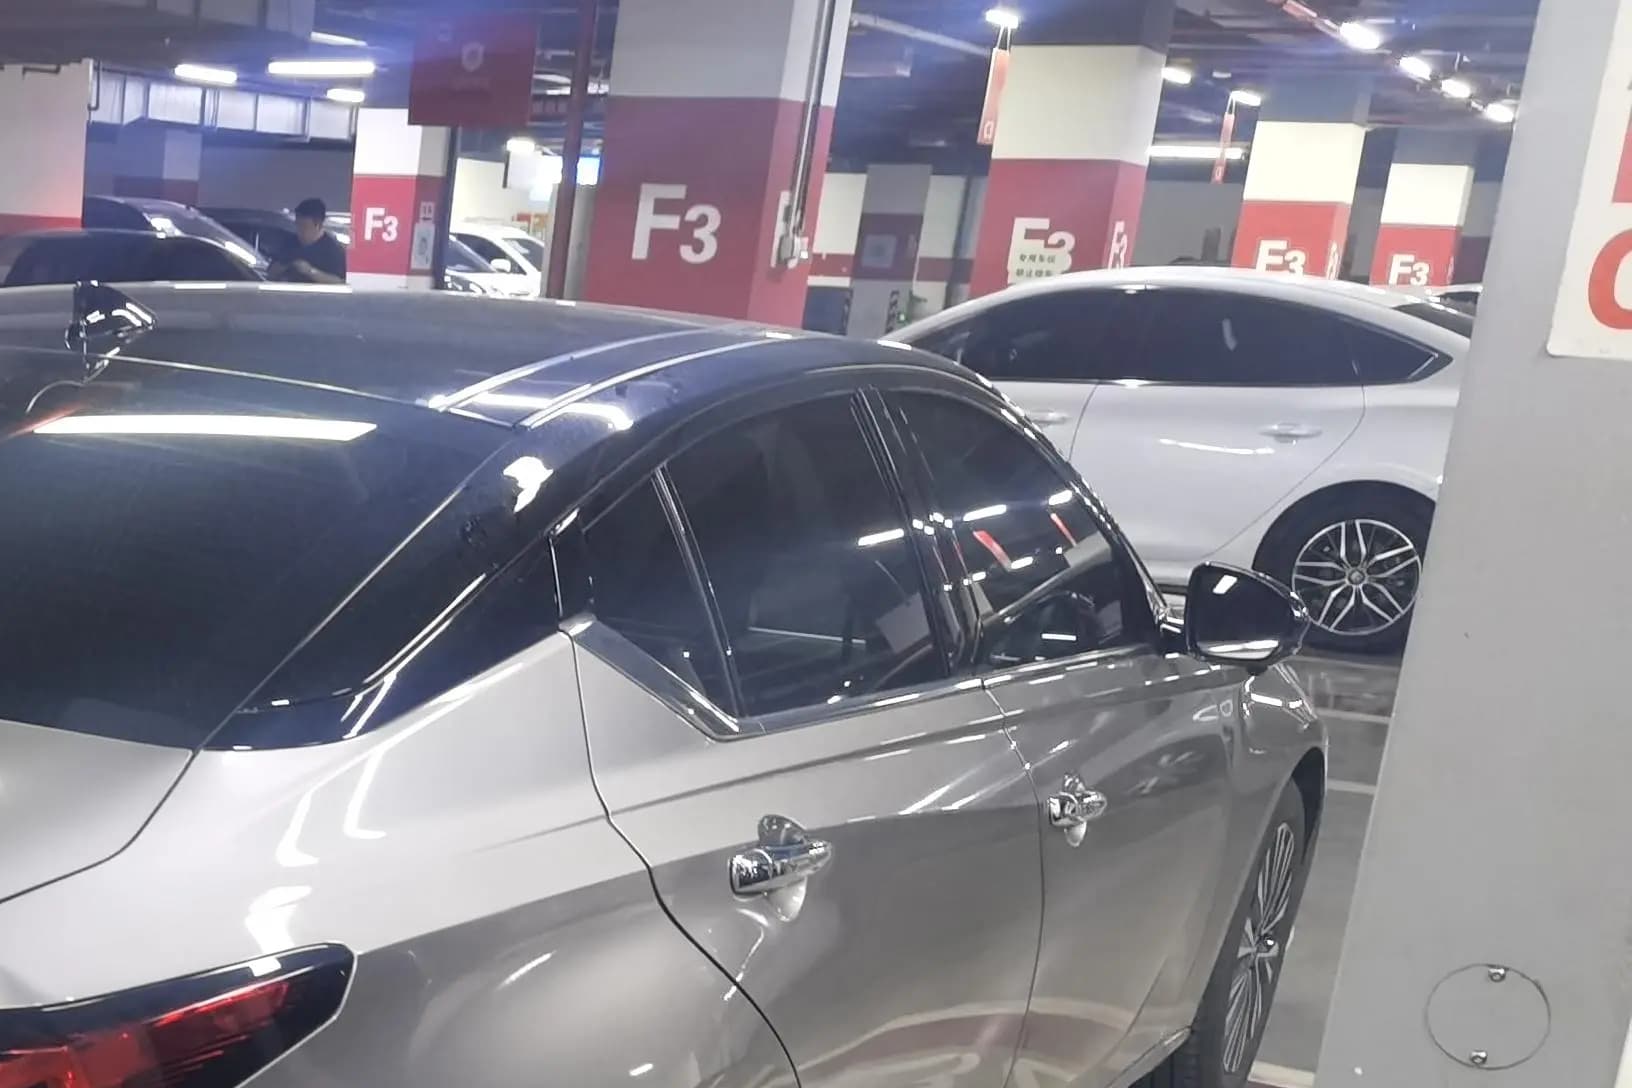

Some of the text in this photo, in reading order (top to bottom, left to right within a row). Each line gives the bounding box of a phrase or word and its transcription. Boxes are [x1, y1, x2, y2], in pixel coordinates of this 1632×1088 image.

[364, 207, 399, 242] F3
[631, 183, 722, 264] F3
[1256, 239, 1307, 279] F3
[1389, 253, 1430, 286] F3
